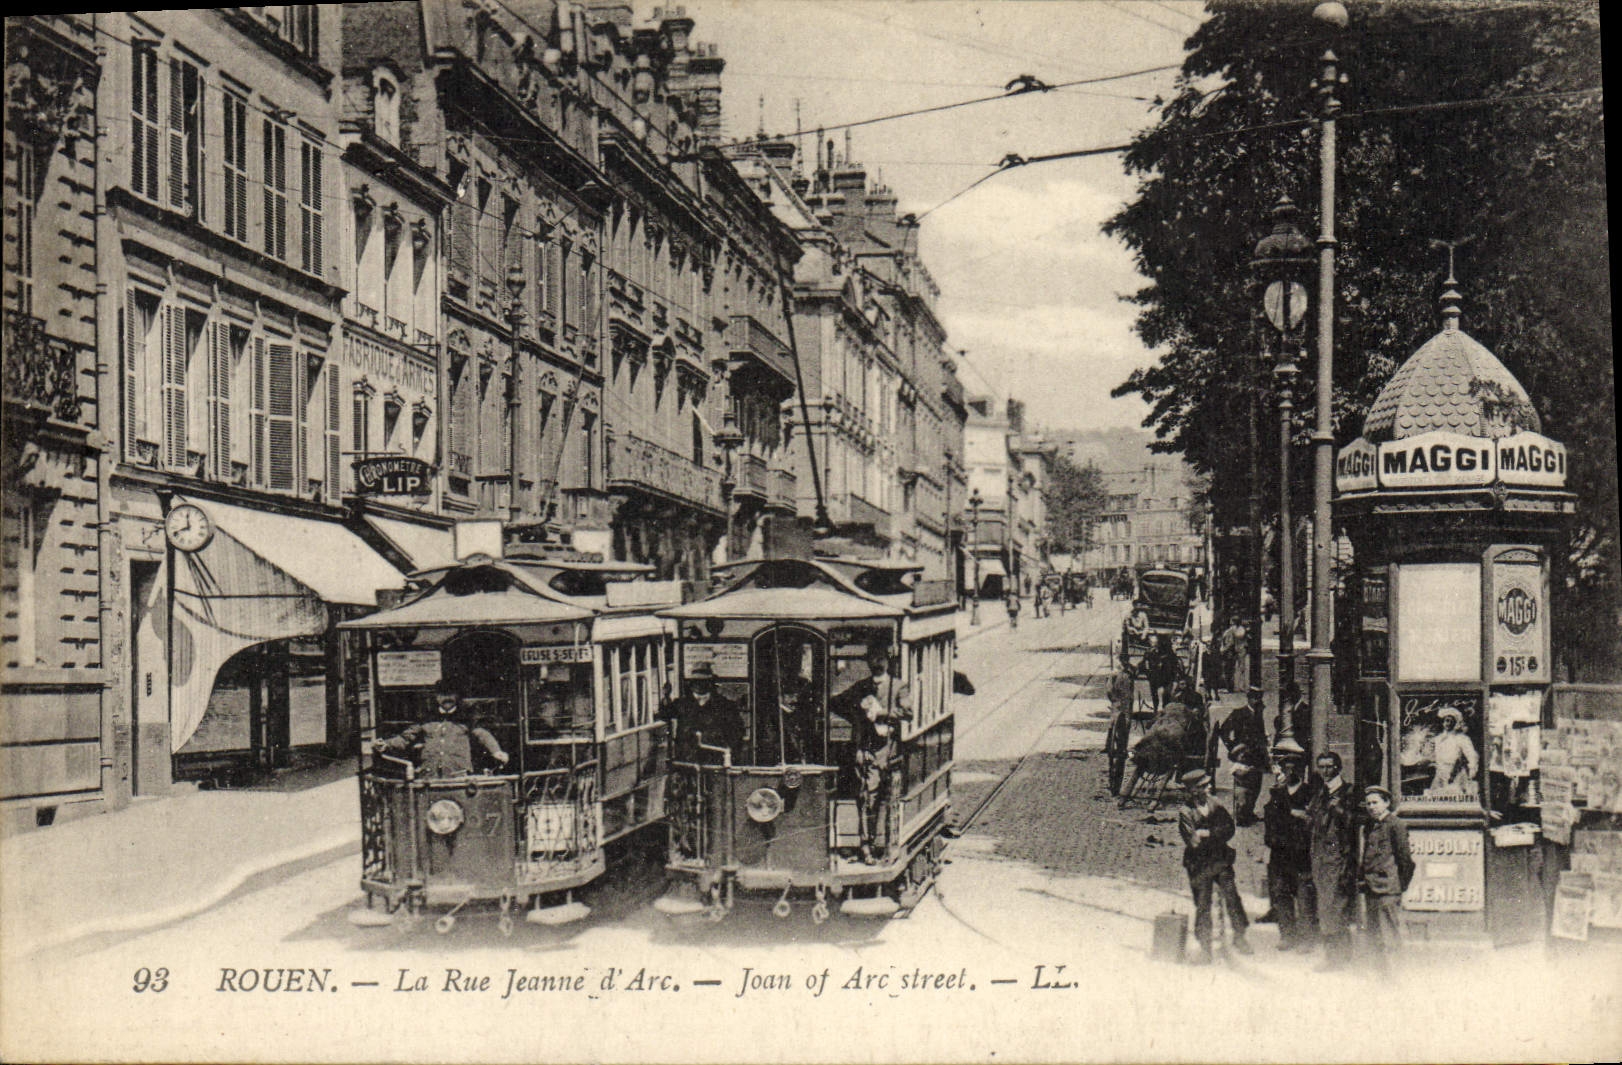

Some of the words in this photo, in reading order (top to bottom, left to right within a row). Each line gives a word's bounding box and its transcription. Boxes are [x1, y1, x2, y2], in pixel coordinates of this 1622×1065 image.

[342, 331, 395, 381] FABRIQUE
[1337, 450, 1375, 478] MAGGI
[1383, 444, 1489, 474] MAGGI
[1500, 444, 1564, 475] MAGGI
[382, 476, 421, 492] LIP
[1498, 596, 1535, 625] MAGGI
[1408, 839, 1480, 856] CHOCOLAT
[1407, 885, 1480, 904] MENIER
